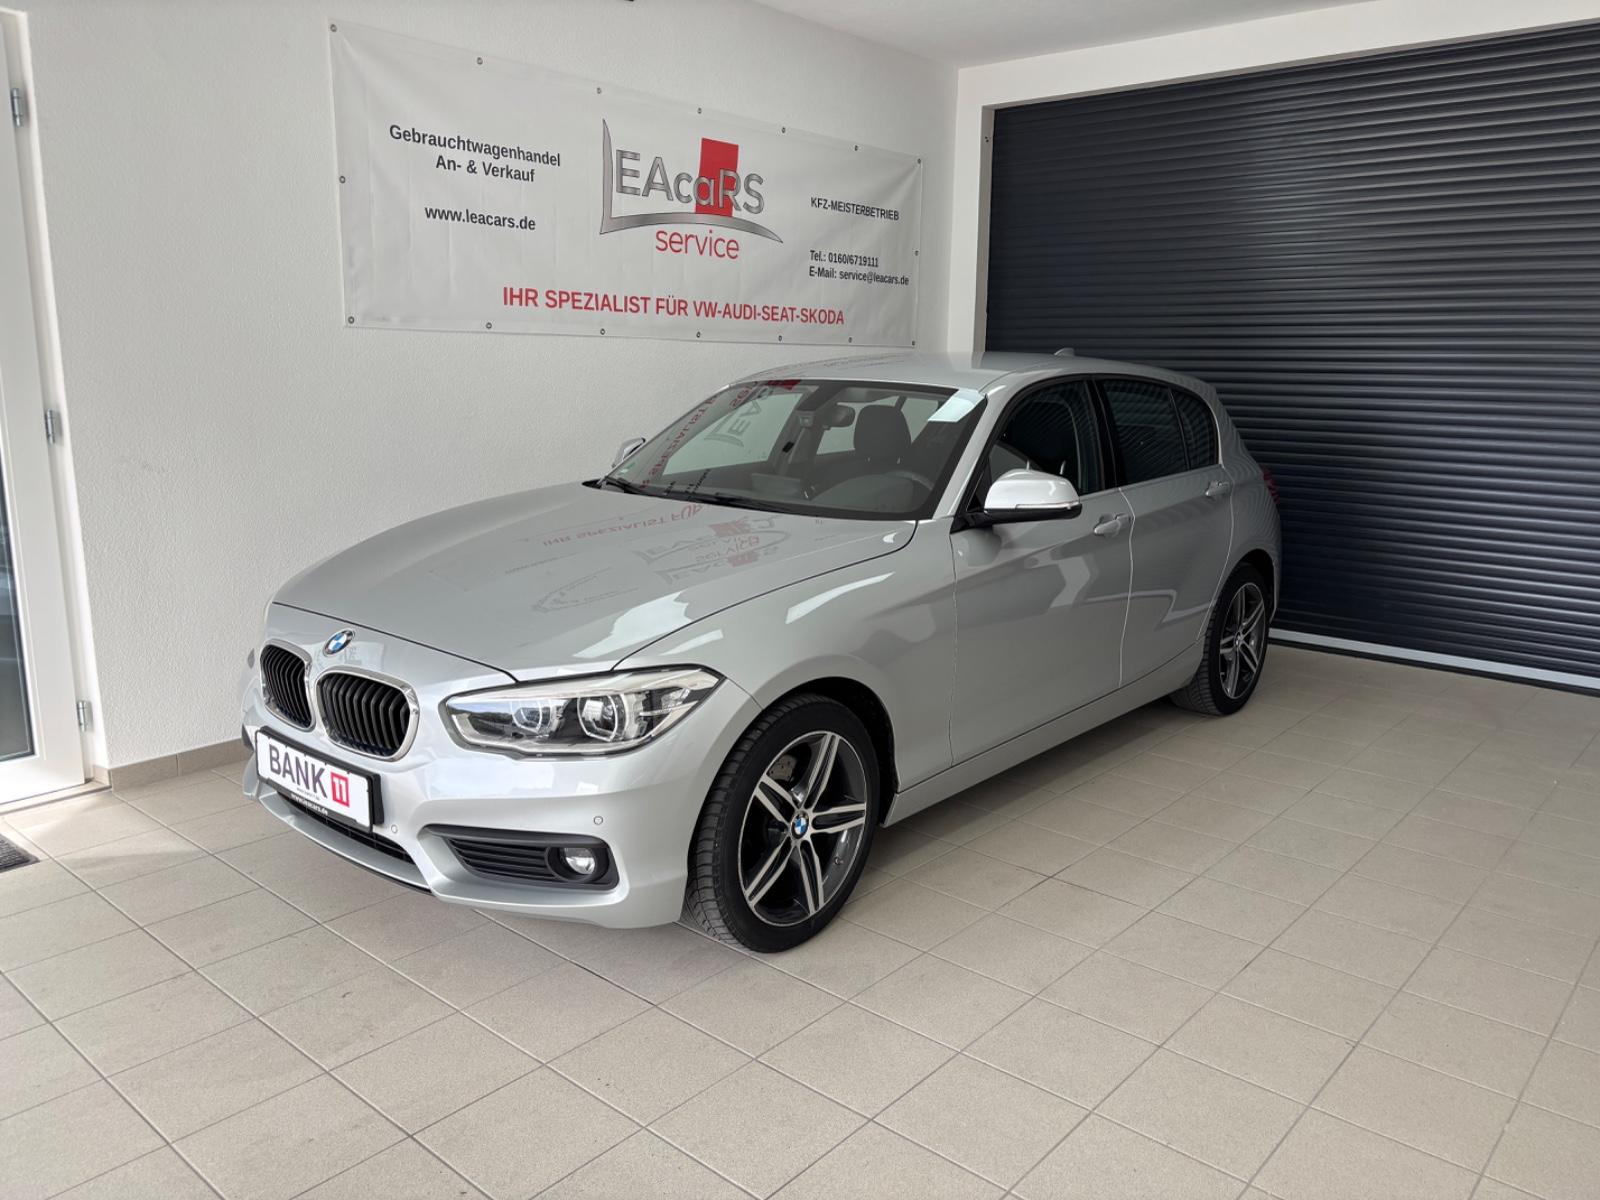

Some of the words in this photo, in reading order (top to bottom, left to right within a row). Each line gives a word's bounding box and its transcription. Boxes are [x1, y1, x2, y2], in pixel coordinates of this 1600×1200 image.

[389, 124, 561, 167] Gebrauchtwagenhandel
[436, 155, 462, 171] An-
[466, 159, 478, 175] &
[482, 161, 536, 182] Verkauf
[424, 206, 536, 230] www.leacars.de
[810, 196, 900, 221] KFZ-MEISTERBETRIEB
[655, 229, 740, 260] service
[810, 249, 826, 262] Tel.:
[828, 252, 879, 268] 0160/6719111
[809, 265, 837, 279] E-Mail:
[839, 269, 910, 285] service@leacars.de
[502, 286, 539, 308] IHR
[545, 290, 651, 315] SPEZIALIST
[655, 294, 689, 317] FÜR
[692, 301, 845, 325] VW-AUDI-SEAT-SKODA
[268, 743, 328, 798] BANK
